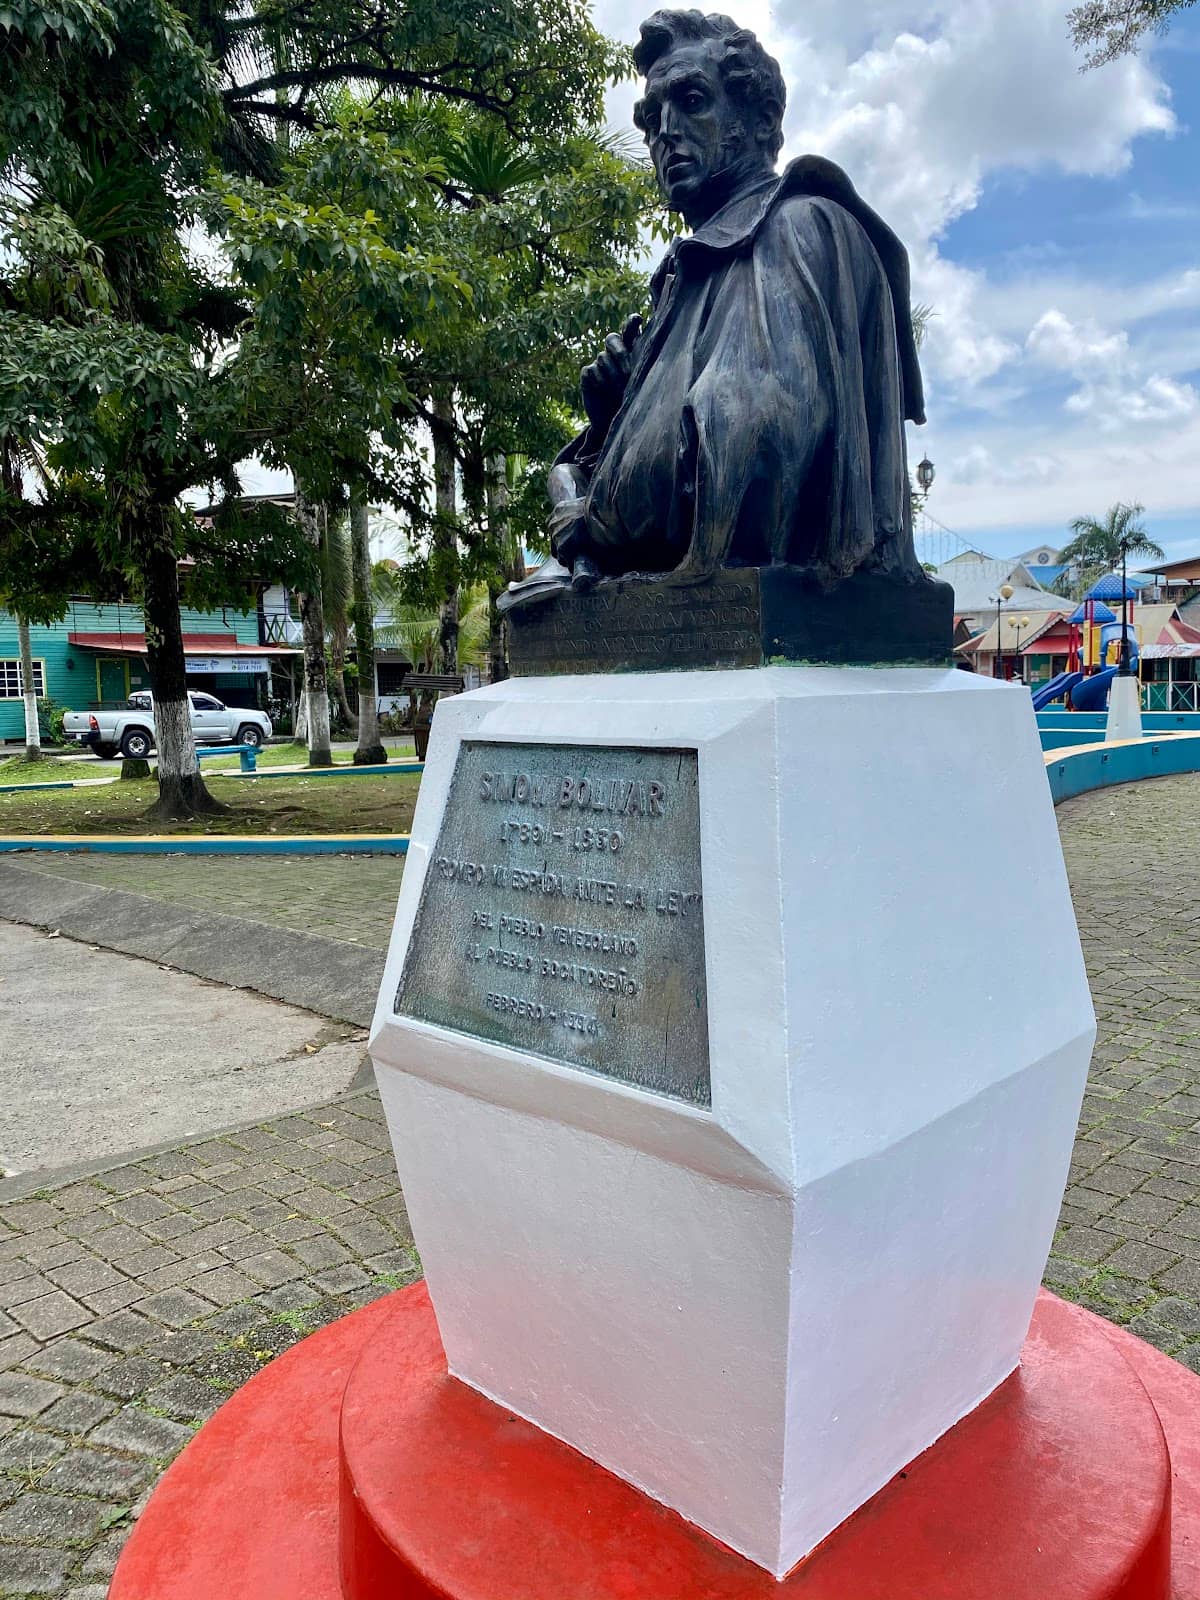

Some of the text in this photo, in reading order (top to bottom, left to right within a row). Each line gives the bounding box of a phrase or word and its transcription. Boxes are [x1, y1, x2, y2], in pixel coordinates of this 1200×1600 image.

[559, 775, 665, 817] BOLIVAR
[471, 910, 493, 930] DEL
[499, 916, 545, 939] PUEBLO
[487, 946, 534, 970] PUEBLO
[486, 991, 544, 1020] FEBRERO
